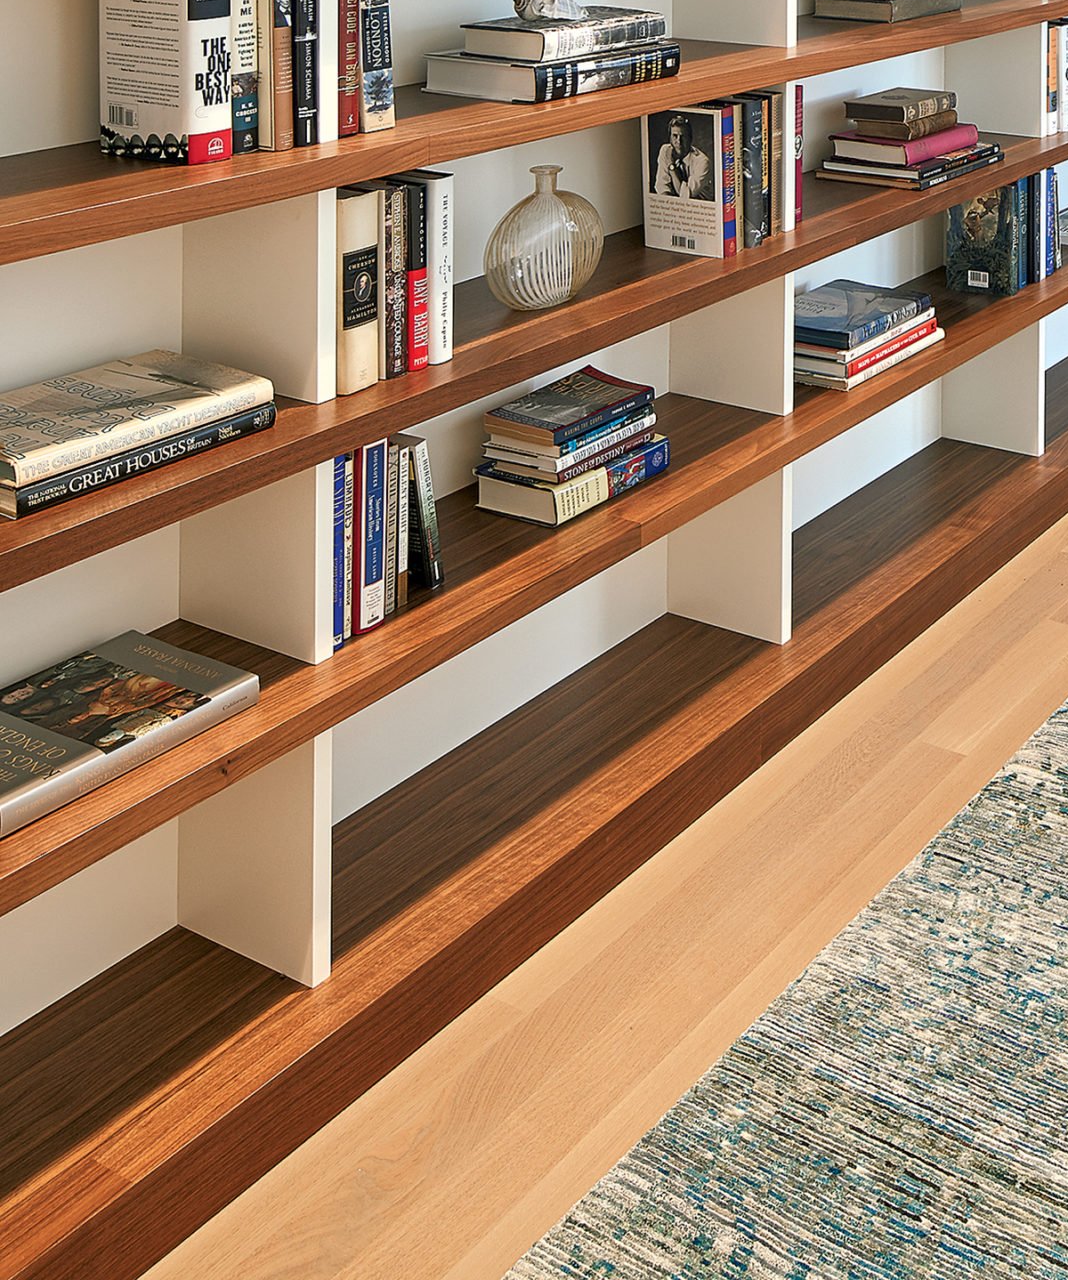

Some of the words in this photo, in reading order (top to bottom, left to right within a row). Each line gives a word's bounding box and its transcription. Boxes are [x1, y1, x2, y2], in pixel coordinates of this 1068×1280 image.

[240, 8, 252, 16] ME
[347, 11, 357, 34] CODE
[201, 37, 227, 56] THE
[370, 12, 383, 67] LONDON
[346, 42, 355, 60] DAN
[208, 53, 231, 72] ONE
[195, 71, 229, 91] BEST
[202, 86, 231, 106] WAY
[414, 278, 428, 306] DAVE
[414, 313, 428, 348] BARRY
[186, 437, 195, 445] OF
[69, 460, 123, 494] GREAT
[125, 440, 187, 474] HOUSES
[564, 462, 588, 480] STONE
[595, 445, 625, 465] DESTINY
[422, 459, 432, 492] HUNGRY
[38, 747, 66, 759] OF
[5, 755, 61, 780] KINGS
